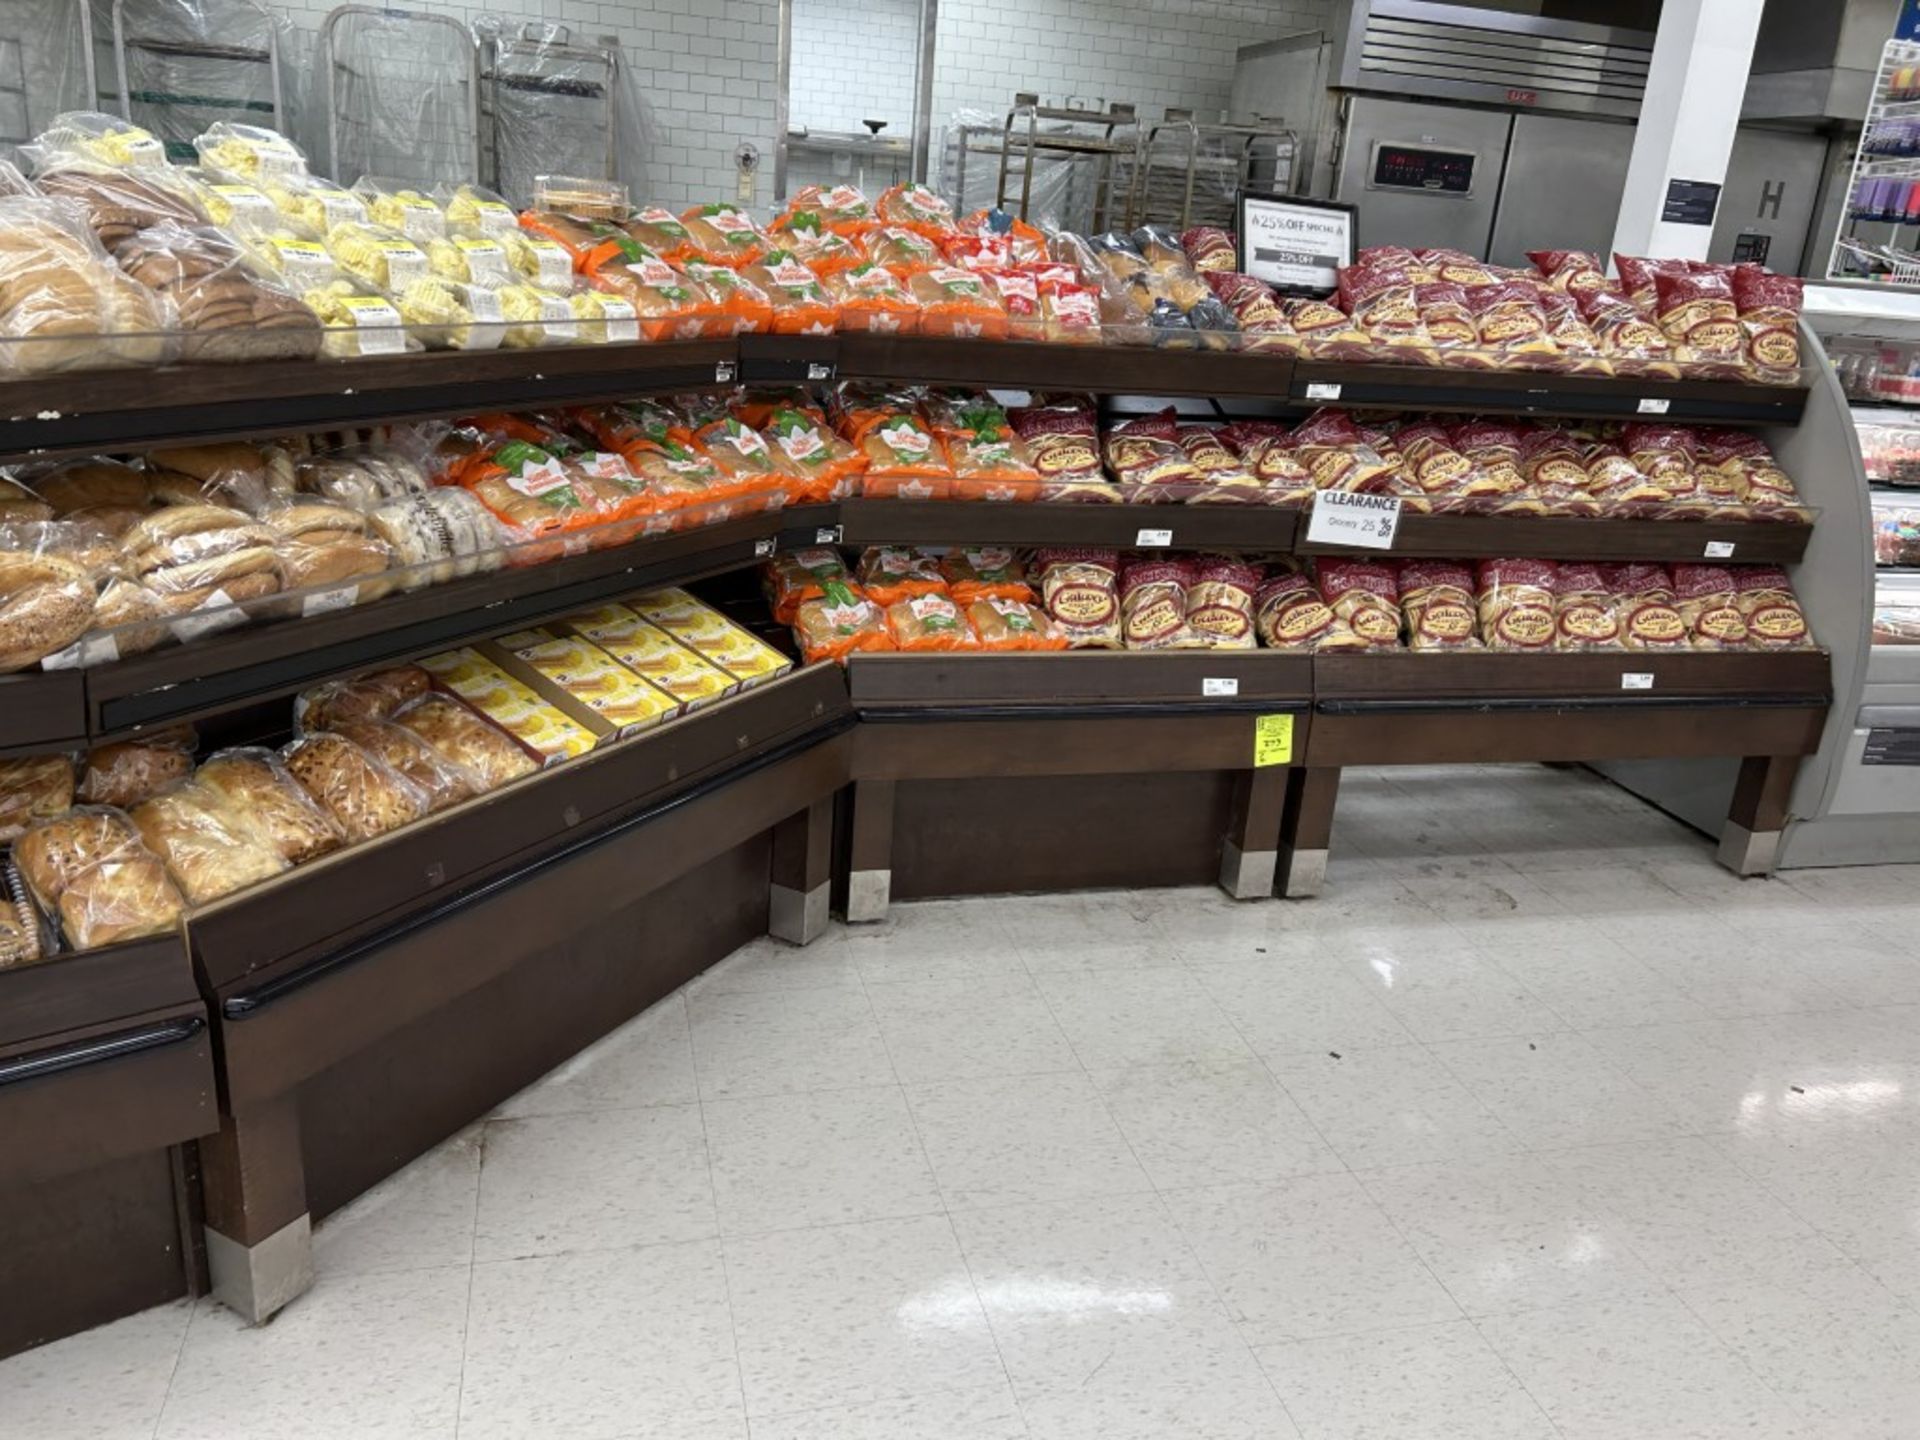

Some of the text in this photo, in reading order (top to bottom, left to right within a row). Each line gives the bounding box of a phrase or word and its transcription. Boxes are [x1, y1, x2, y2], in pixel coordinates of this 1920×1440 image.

[1757, 180, 1785, 220] H
[1324, 492, 1398, 511] CLEARANCE
[1361, 519, 1375, 532] 25
